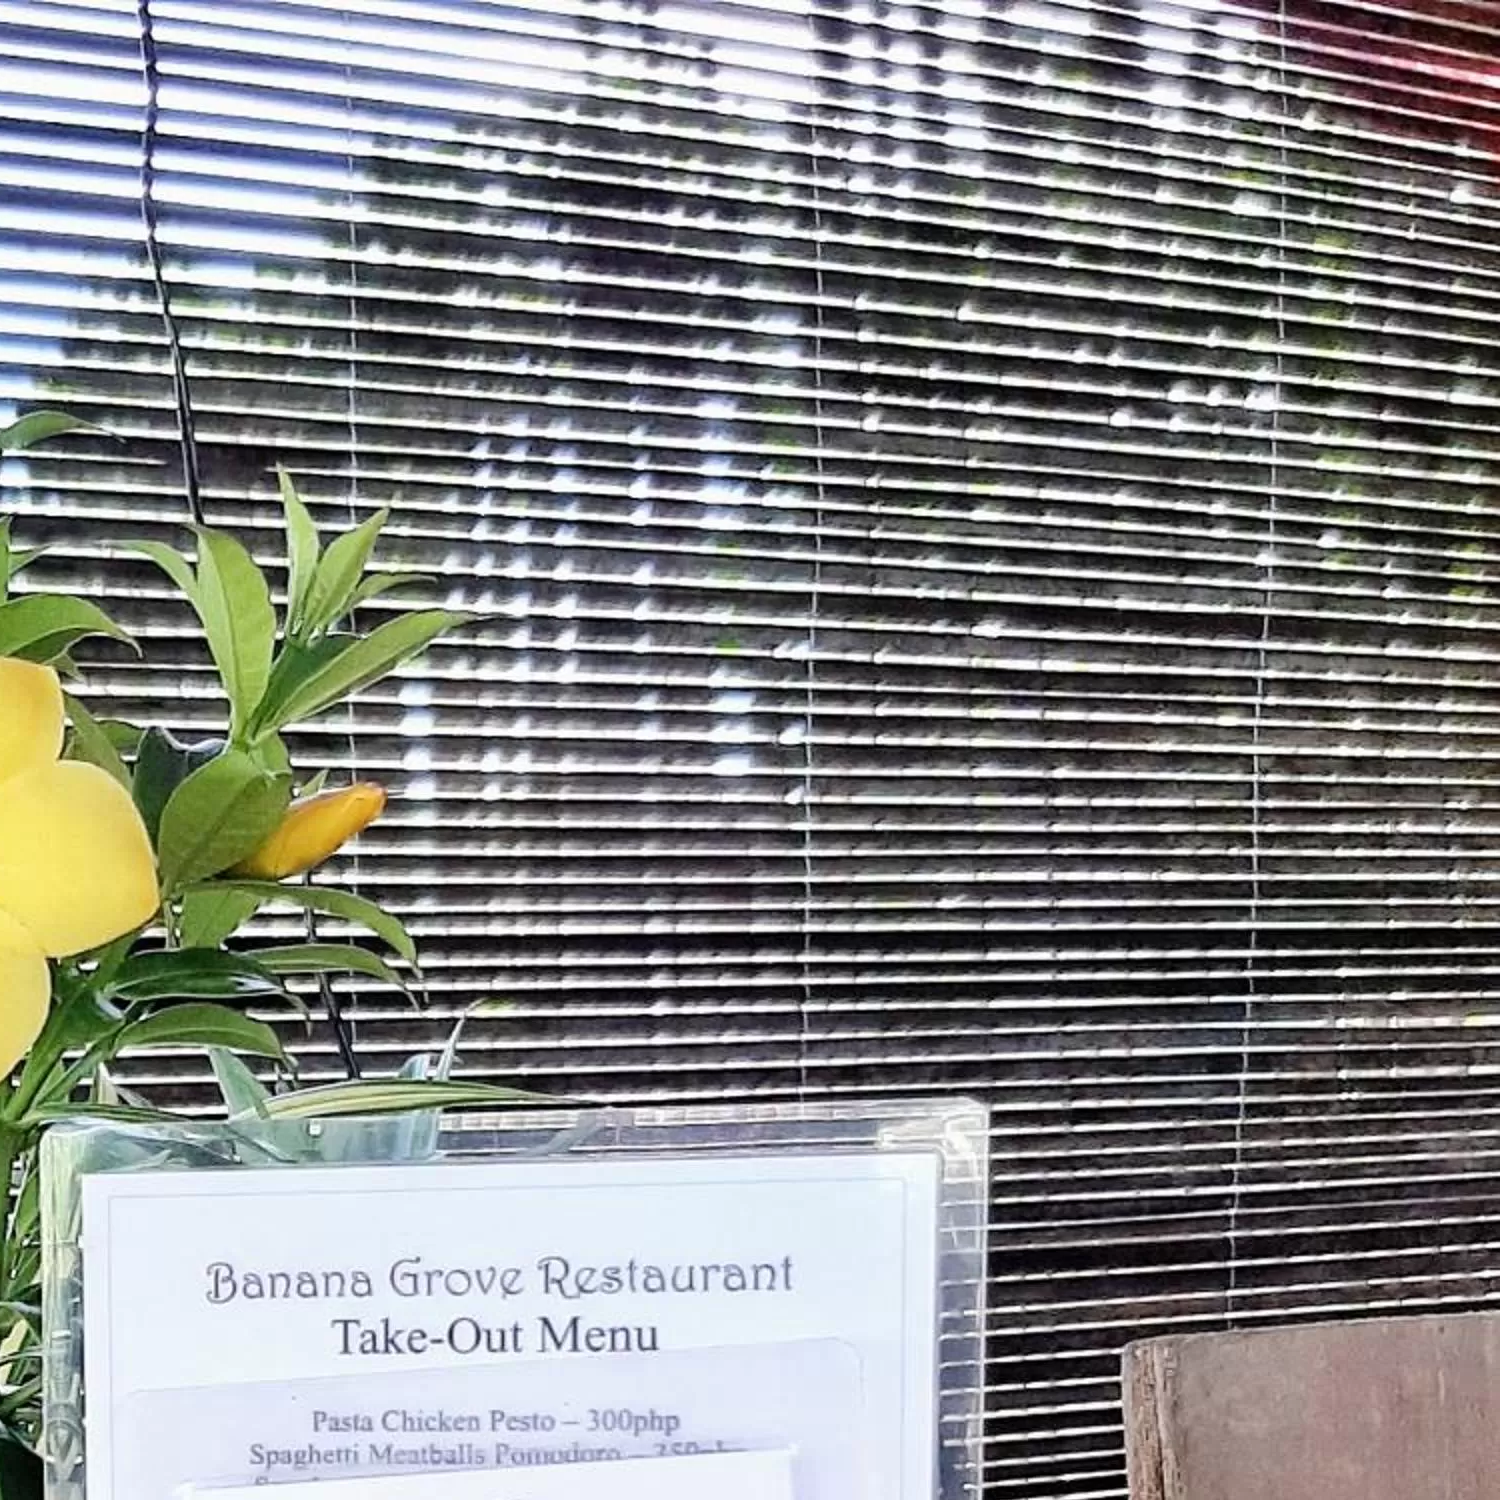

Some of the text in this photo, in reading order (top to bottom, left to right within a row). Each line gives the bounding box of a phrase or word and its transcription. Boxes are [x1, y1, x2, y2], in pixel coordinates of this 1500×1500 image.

[205, 1255, 794, 1304] Banana Grove Restaurant
[331, 1315, 661, 1355] Take-Out Menu
[312, 1409, 374, 1433] Pasta
[381, 1409, 481, 1433] Chicken
[489, 1408, 557, 1433] Pesto
[586, 1407, 682, 1437] 300php
[249, 1443, 359, 1471] Spaghetti
[368, 1443, 486, 1466] Meatballs
